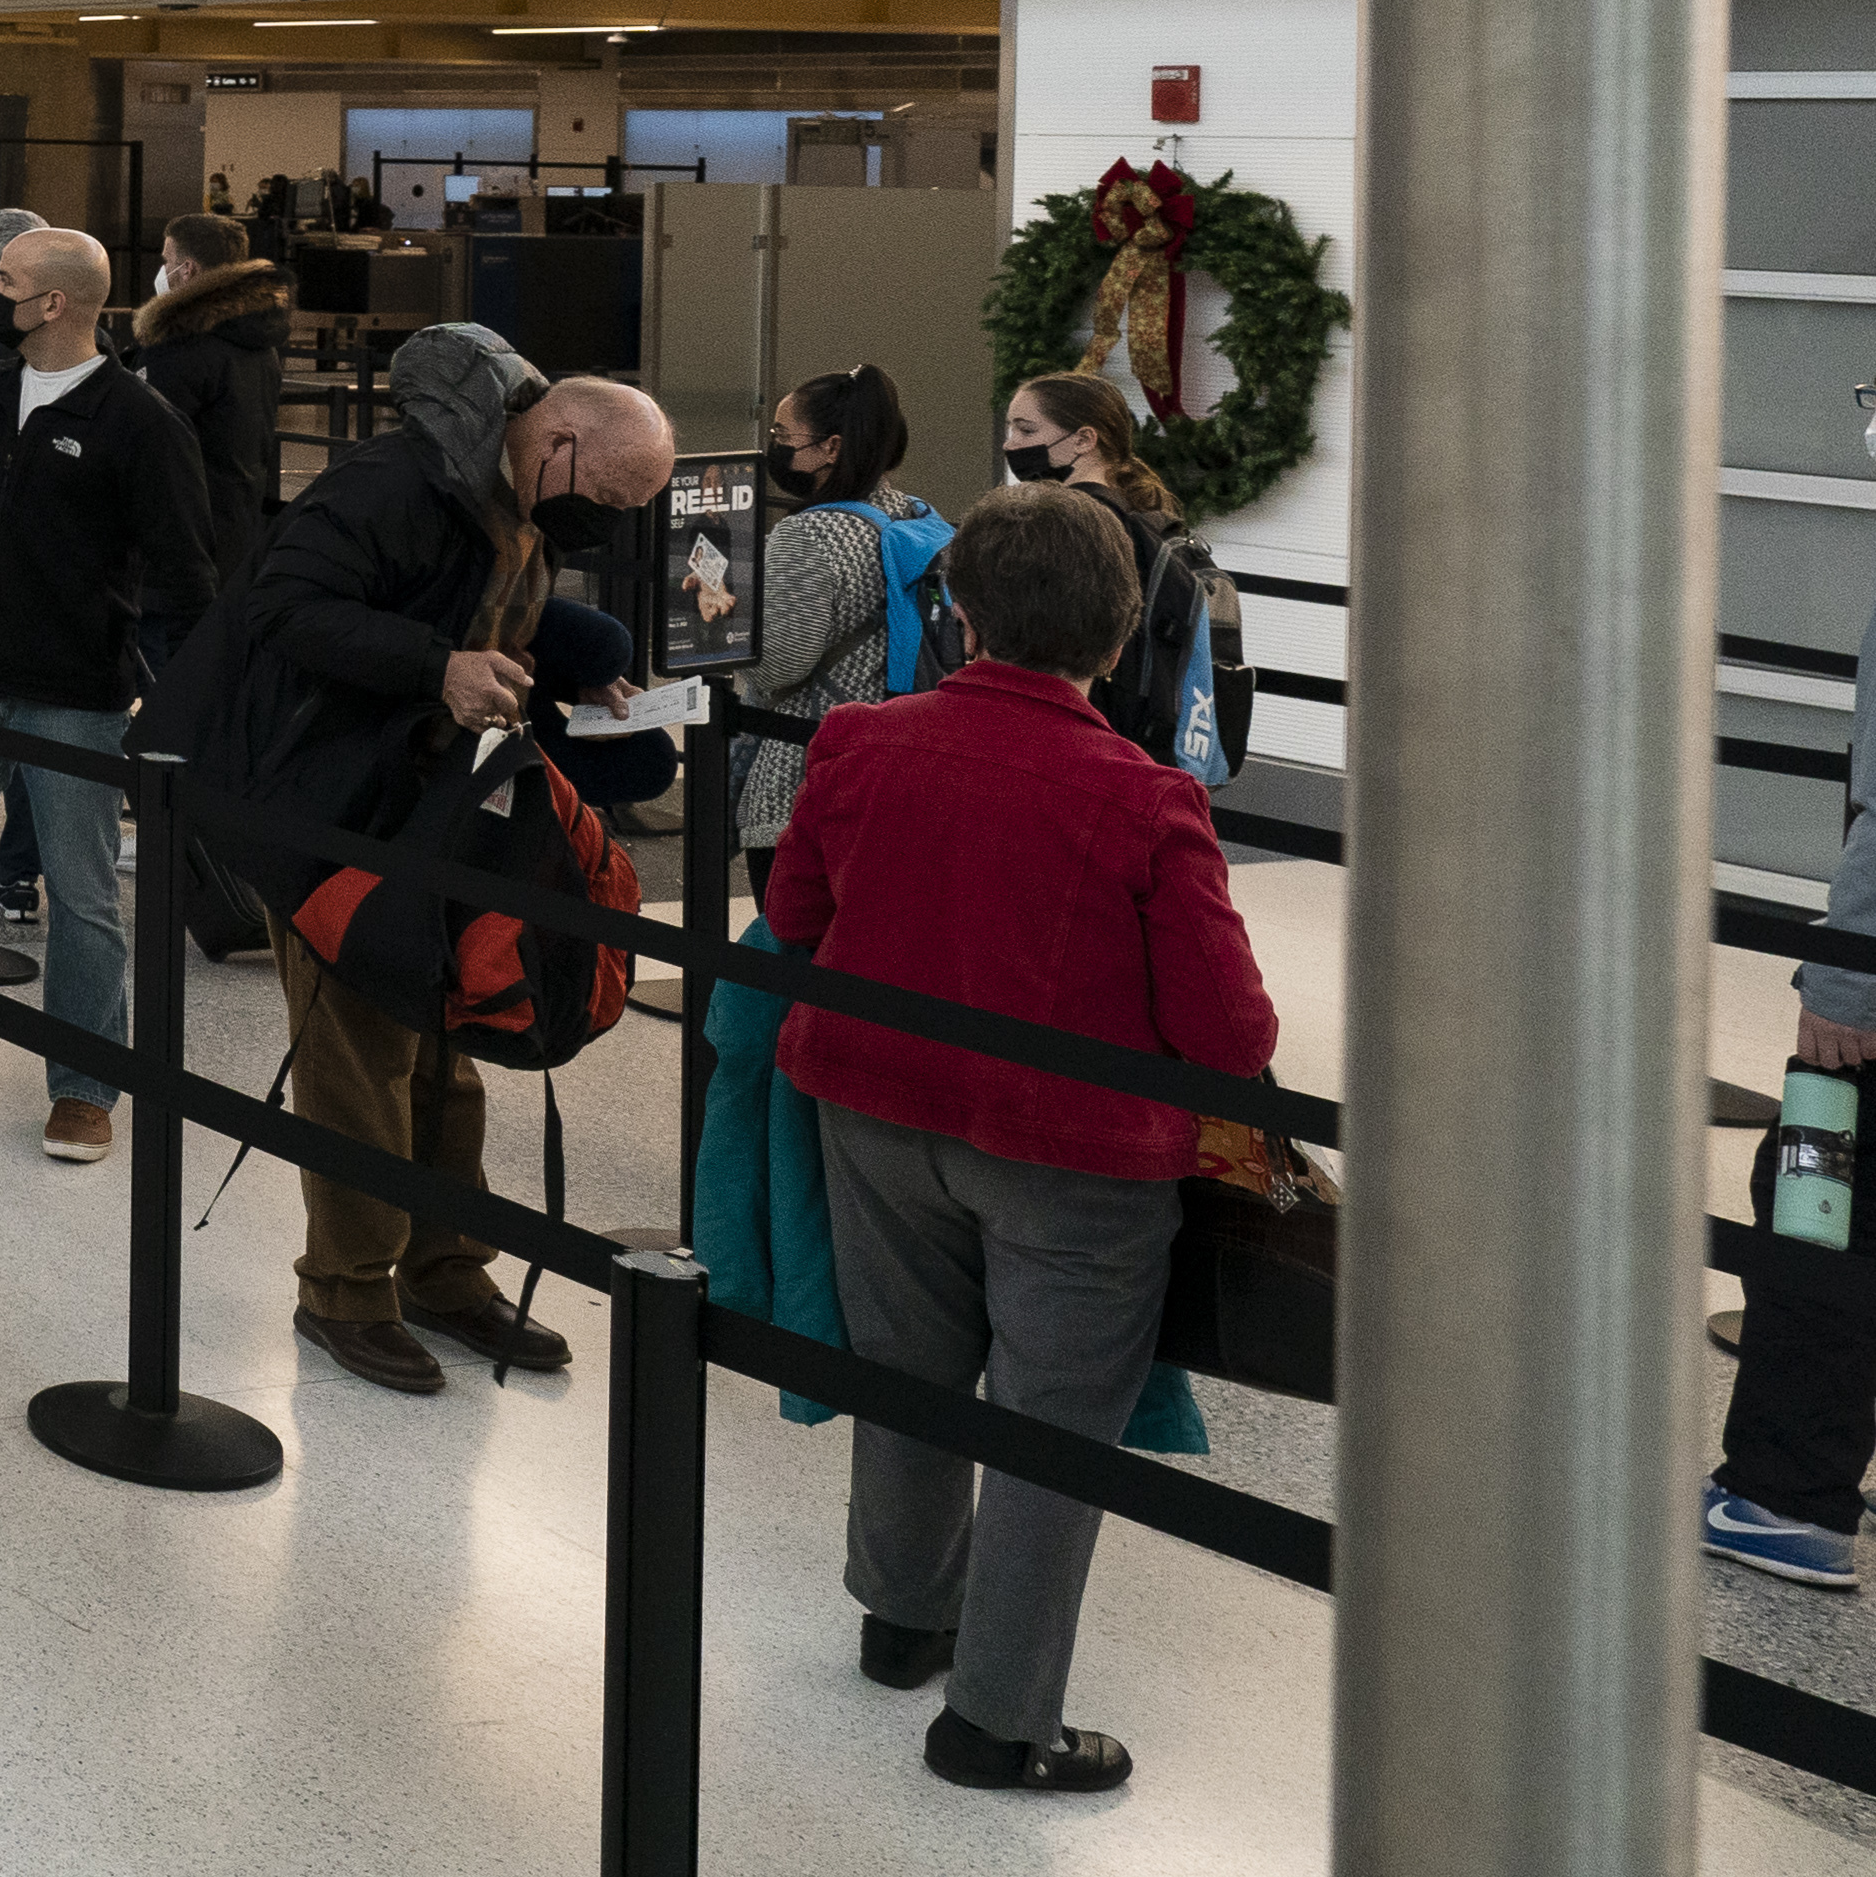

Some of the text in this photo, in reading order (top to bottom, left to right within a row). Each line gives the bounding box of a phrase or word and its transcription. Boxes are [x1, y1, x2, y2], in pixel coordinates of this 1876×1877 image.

[671, 475, 700, 488] BE YOUR
[671, 484, 754, 517] REAL ID
[670, 517, 685, 530] SELF
[1183, 686, 1214, 762] STX
